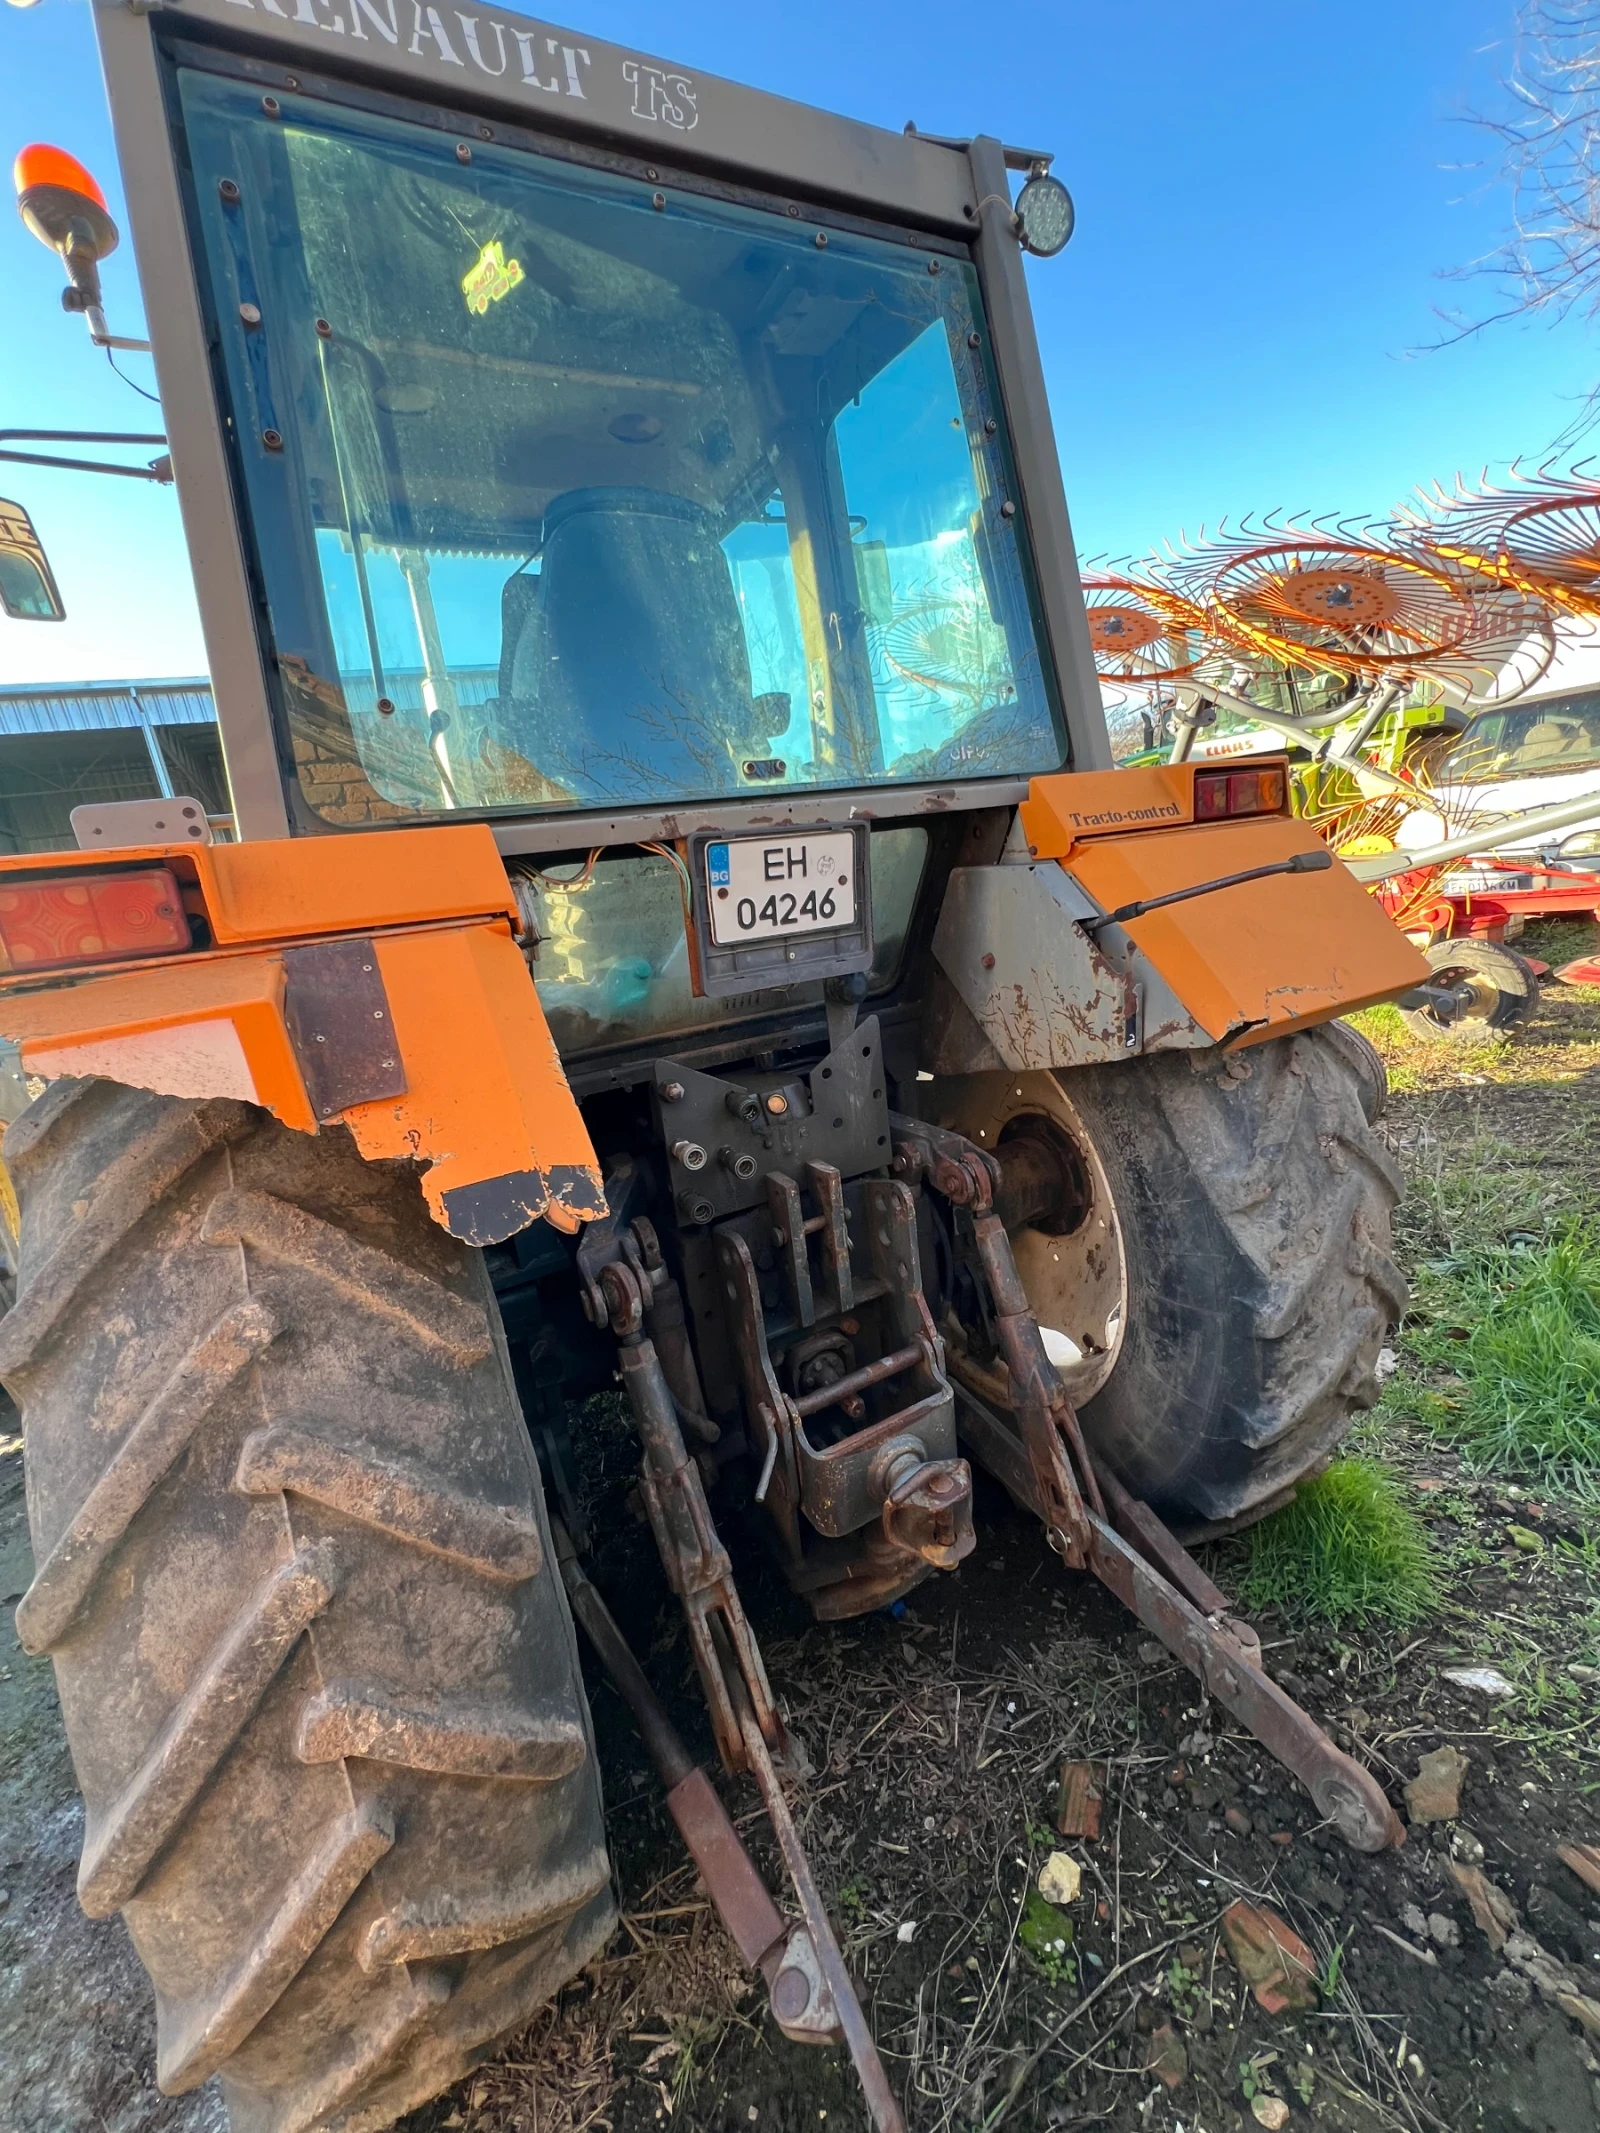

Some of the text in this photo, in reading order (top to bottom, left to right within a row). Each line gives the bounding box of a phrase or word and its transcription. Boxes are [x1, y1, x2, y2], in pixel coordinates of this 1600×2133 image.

[225, 0, 699, 130] ENAULT TS
[1069, 802, 1181, 827] Tracto-control
[711, 870, 729, 882] BG
[764, 845, 807, 881] EH
[737, 887, 836, 930] 04246
